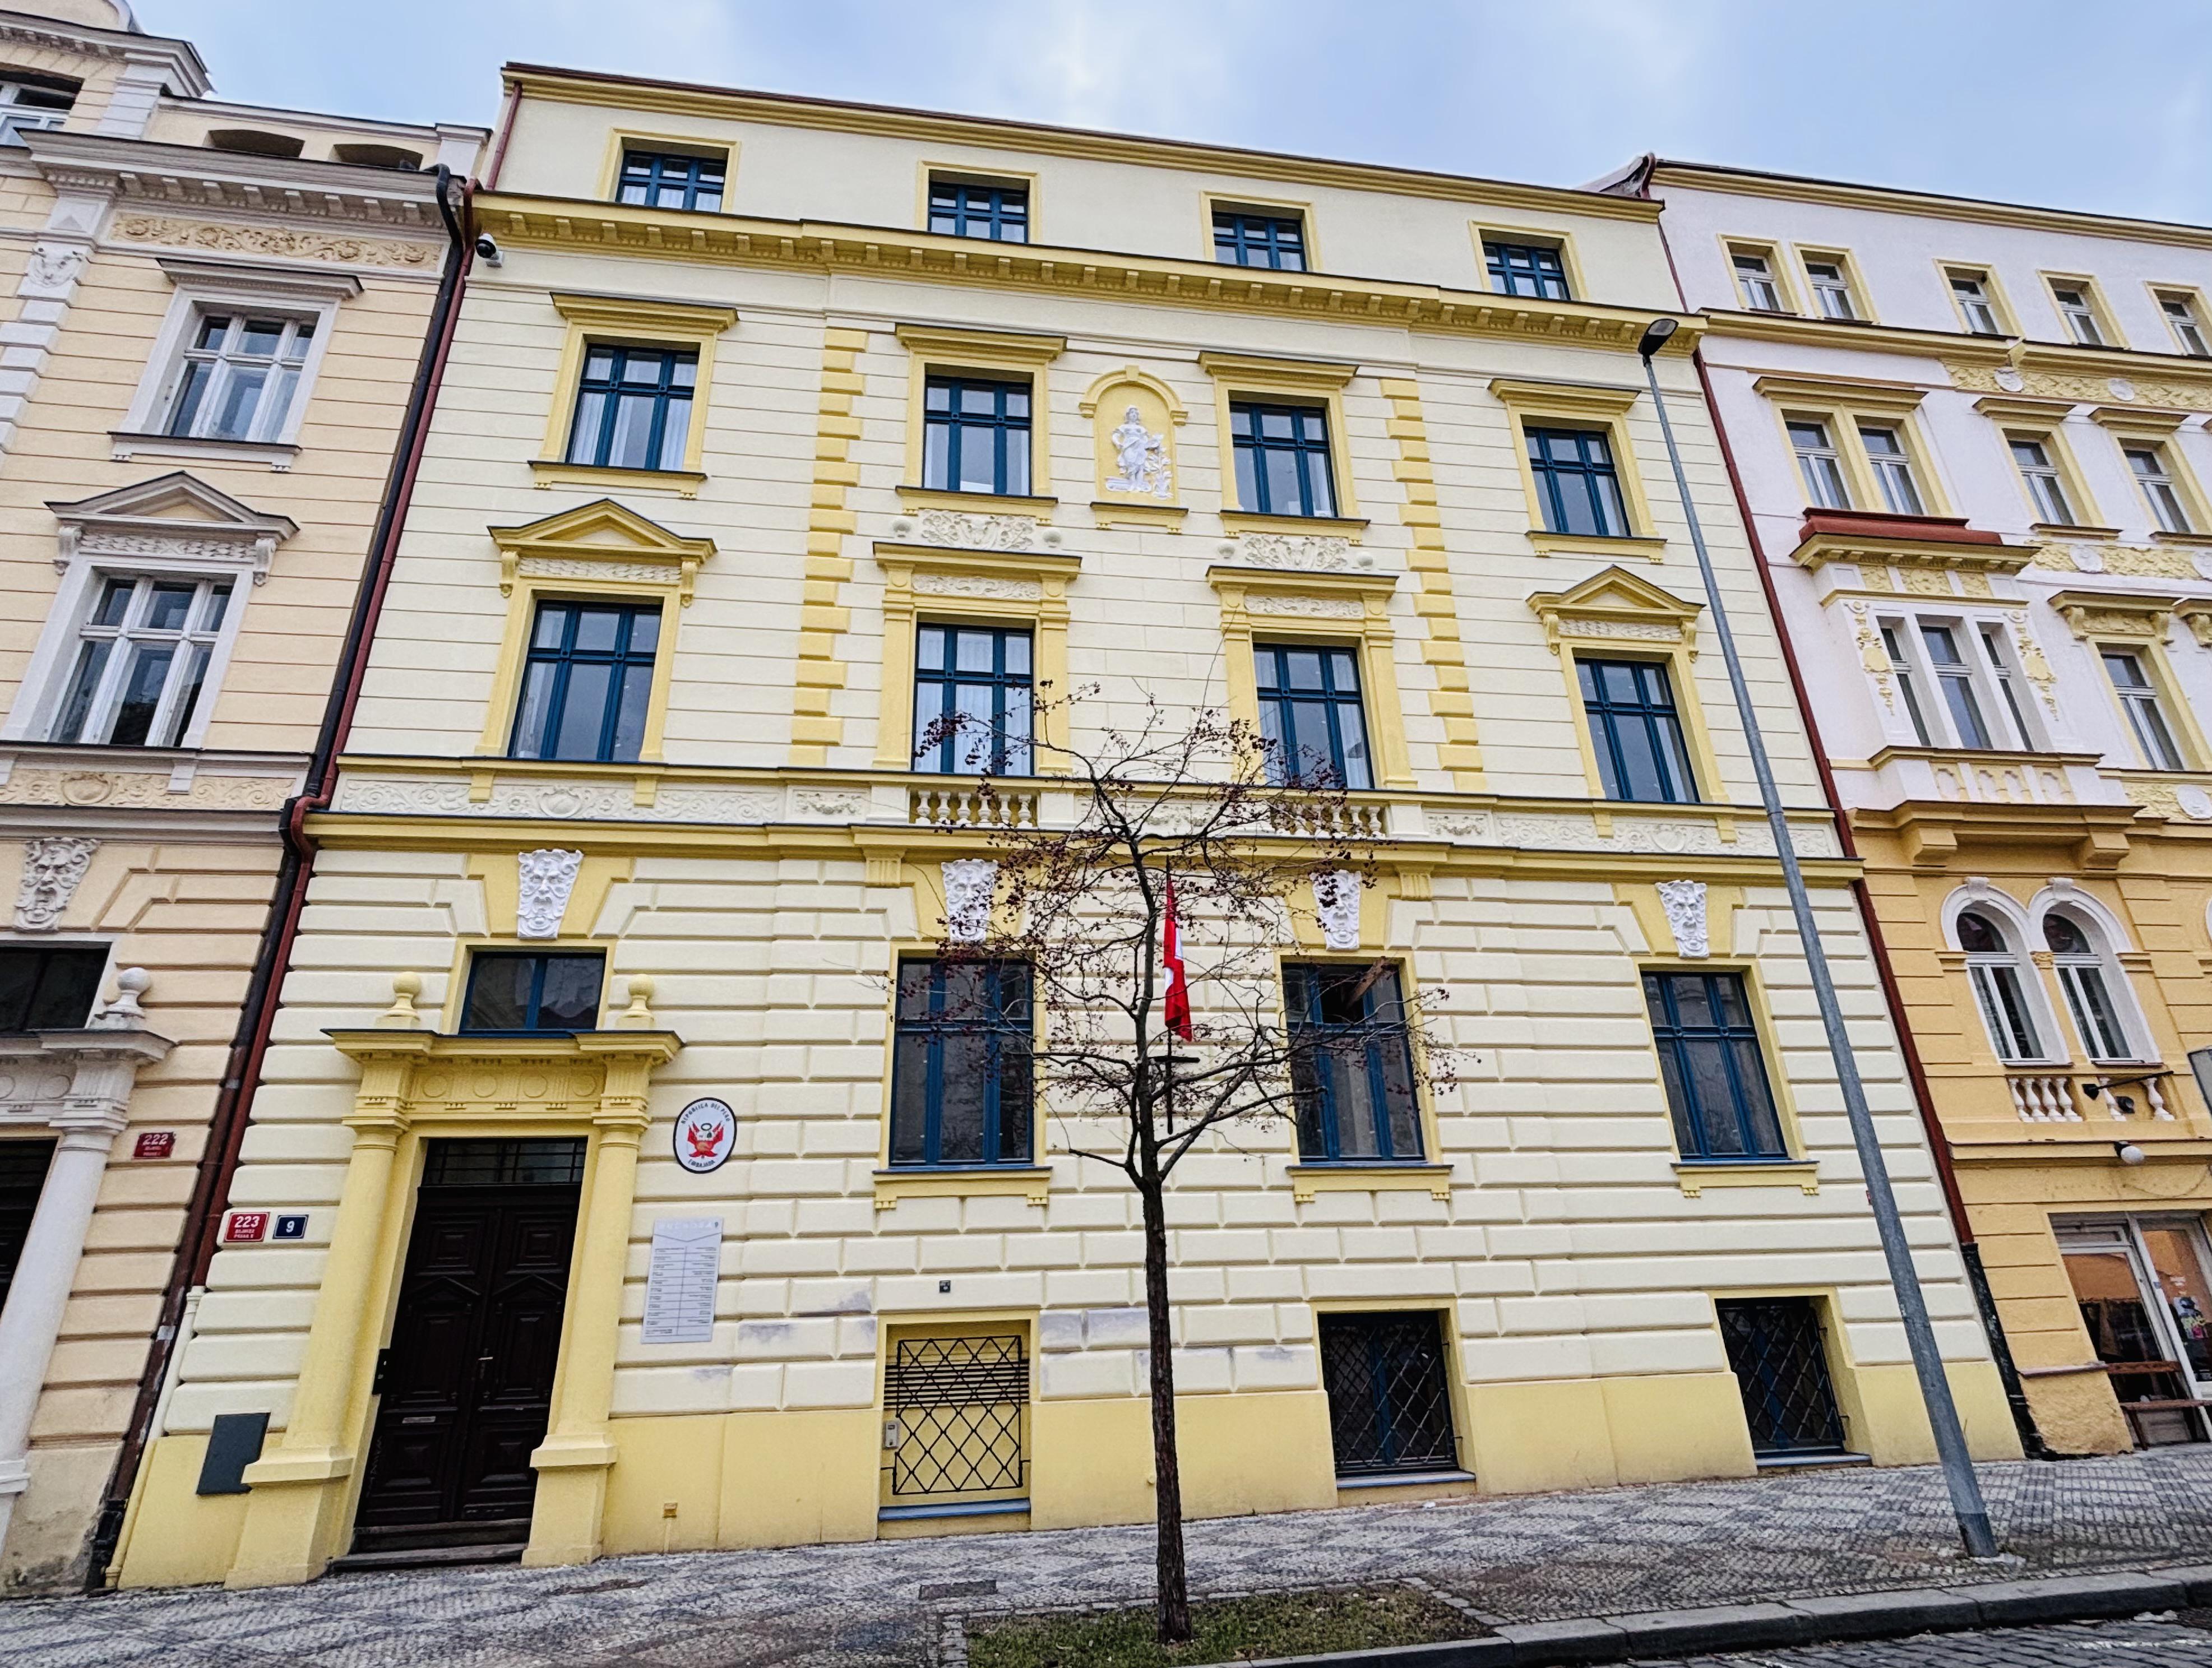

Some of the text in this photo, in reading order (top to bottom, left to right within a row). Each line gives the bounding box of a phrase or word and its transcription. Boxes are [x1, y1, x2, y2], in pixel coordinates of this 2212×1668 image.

[142, 1134, 168, 1145] 222
[234, 1215, 260, 1228] 223
[285, 1220, 295, 1233] 9
